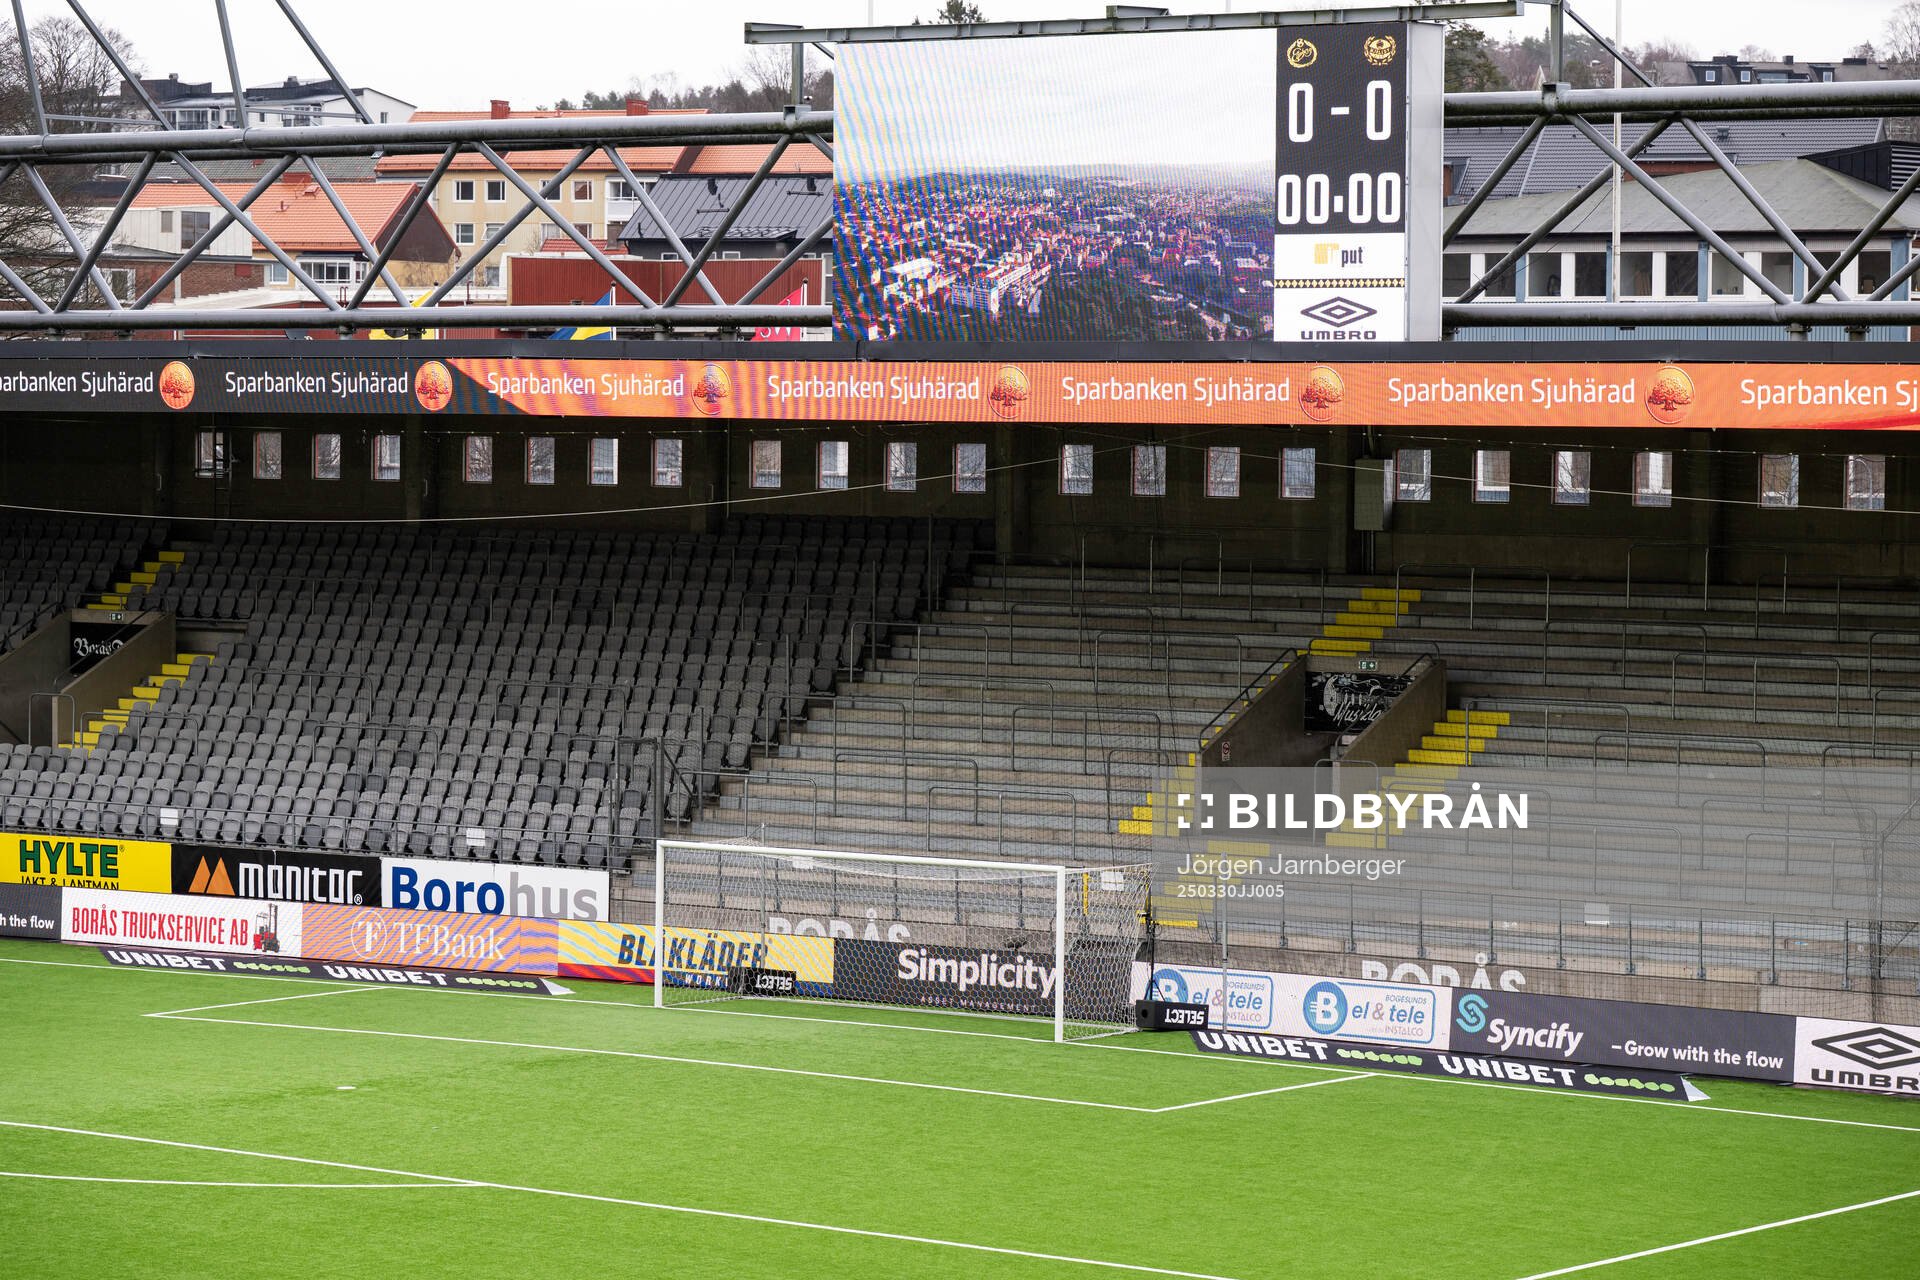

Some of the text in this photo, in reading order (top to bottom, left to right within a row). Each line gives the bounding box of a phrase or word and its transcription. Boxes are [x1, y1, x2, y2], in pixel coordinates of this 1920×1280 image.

[1289, 83, 1313, 142] 0
[1367, 80, 1391, 140] 0
[1341, 246, 1363, 267] put
[1301, 331, 1376, 340] UMBRO
[81, 371, 153, 397] Sjuhärad
[226, 371, 408, 399] Sparbanken Sjuhärad
[487, 372, 684, 400] Sparbanken Sjuhärad
[768, 374, 979, 404] Sparbanken Sjuhärad
[1062, 377, 1290, 406] Sparbanken Sjuhärad
[1388, 377, 1635, 408] Sparbanken Sjuhärad
[1740, 379, 1887, 410] Sparbanken
[391, 866, 598, 921] Borohus
[9, 914, 27, 927] the
[30, 915, 55, 930] flow
[72, 904, 249, 946] BORÅS TRUCKSERVICE AB
[107, 950, 227, 971] UNIBET
[898, 948, 1057, 998] Simplicity
[323, 965, 447, 986] UNIBET
[756, 974, 793, 991] SELECT
[1193, 988, 1210, 1005] el
[1228, 990, 1263, 1010] tele
[1352, 1001, 1425, 1024] el & tele
[1165, 1008, 1205, 1025] SELECT
[1199, 1031, 1328, 1061] UNIBET
[1486, 1018, 1584, 1057] Syncify
[1624, 1039, 1668, 1059] Grow
[1673, 1045, 1708, 1062] with
[1714, 1048, 1742, 1065] the
[1745, 1050, 1783, 1069] flow
[1437, 1055, 1576, 1087] UNIBET
[1811, 1068, 1920, 1092] UMBR
